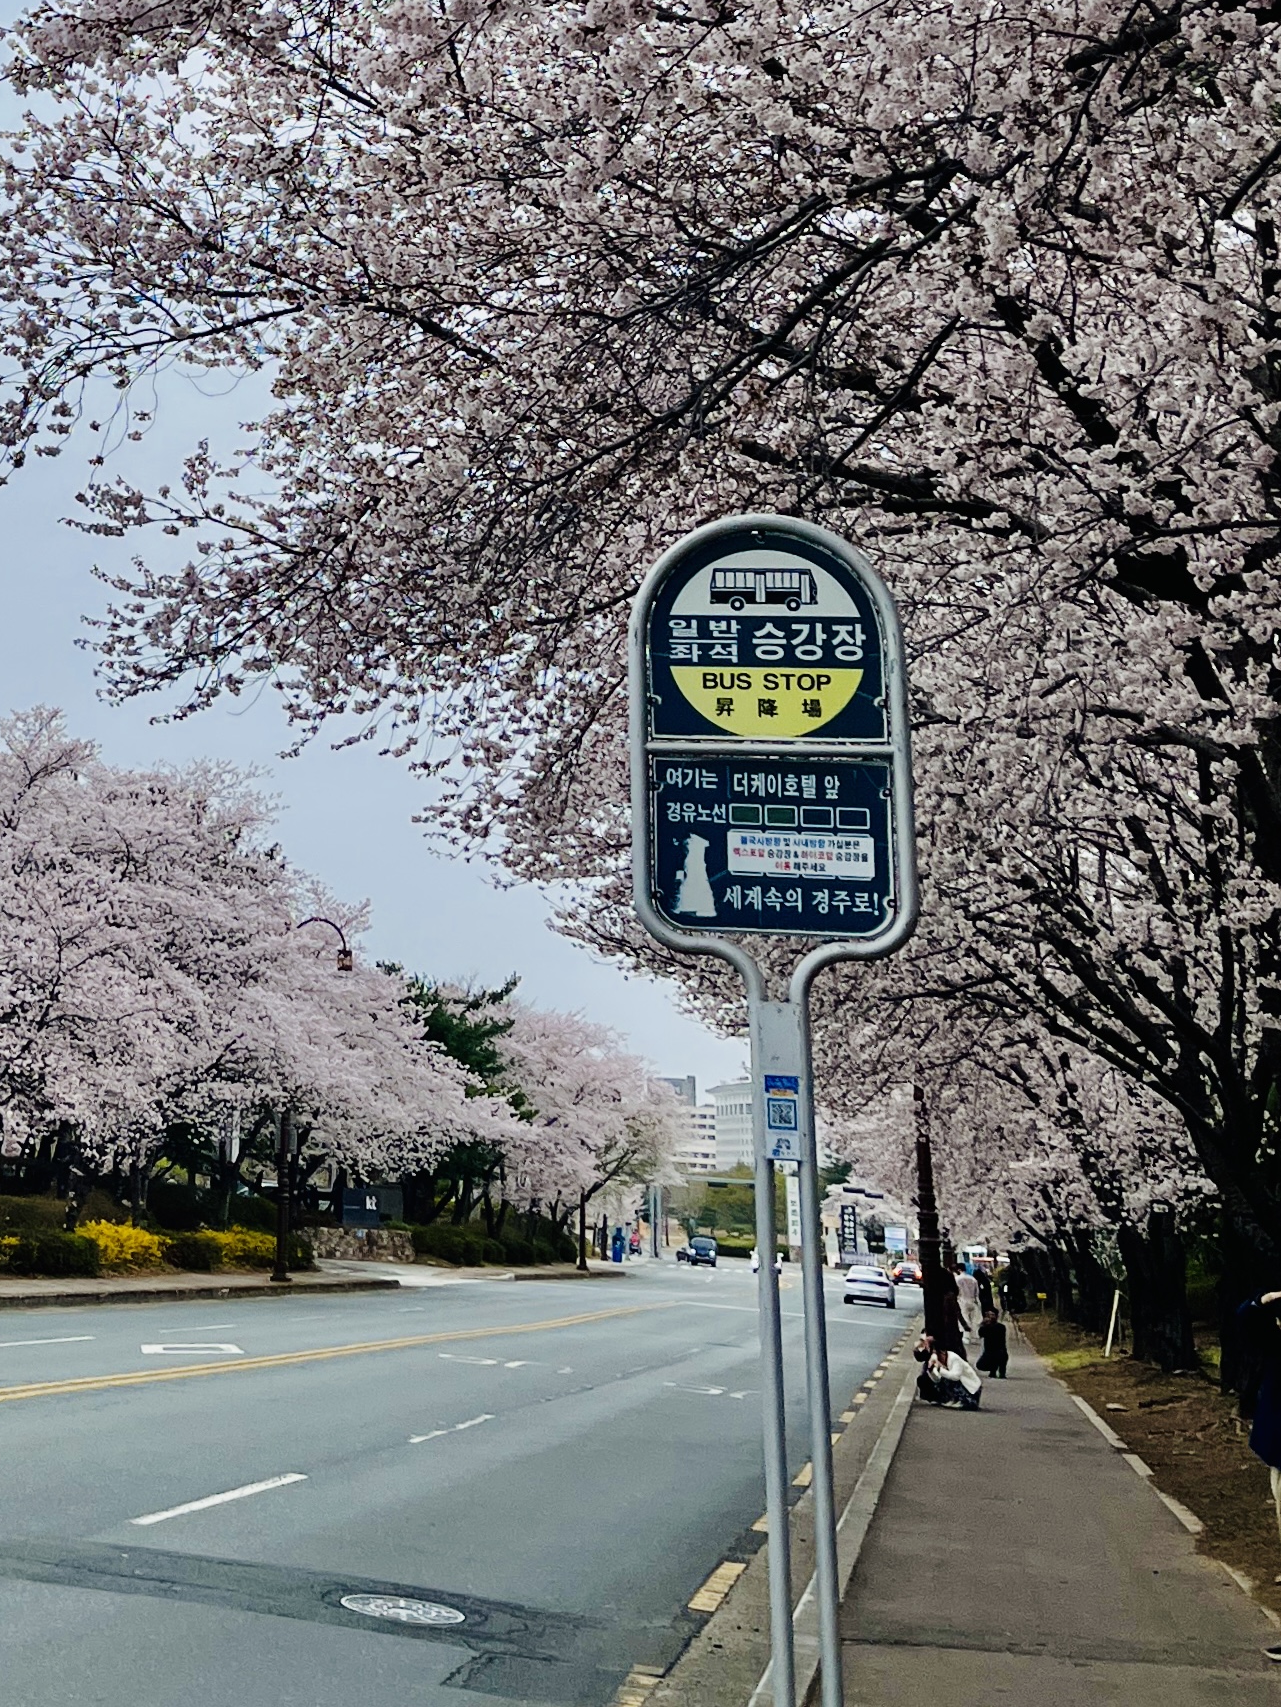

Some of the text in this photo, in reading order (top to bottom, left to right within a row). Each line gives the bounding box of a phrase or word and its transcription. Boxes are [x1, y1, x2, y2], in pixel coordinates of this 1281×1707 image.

[668, 619, 741, 638] 일반
[752, 622, 866, 661] 승강장
[669, 644, 739, 663] 좌석
[702, 672, 832, 692] BUS STOP
[665, 767, 840, 799] 여기는 더케이호텔 앞
[666, 802, 727, 824] 경유노선
[723, 885, 879, 915] 세계속의 경주로!
